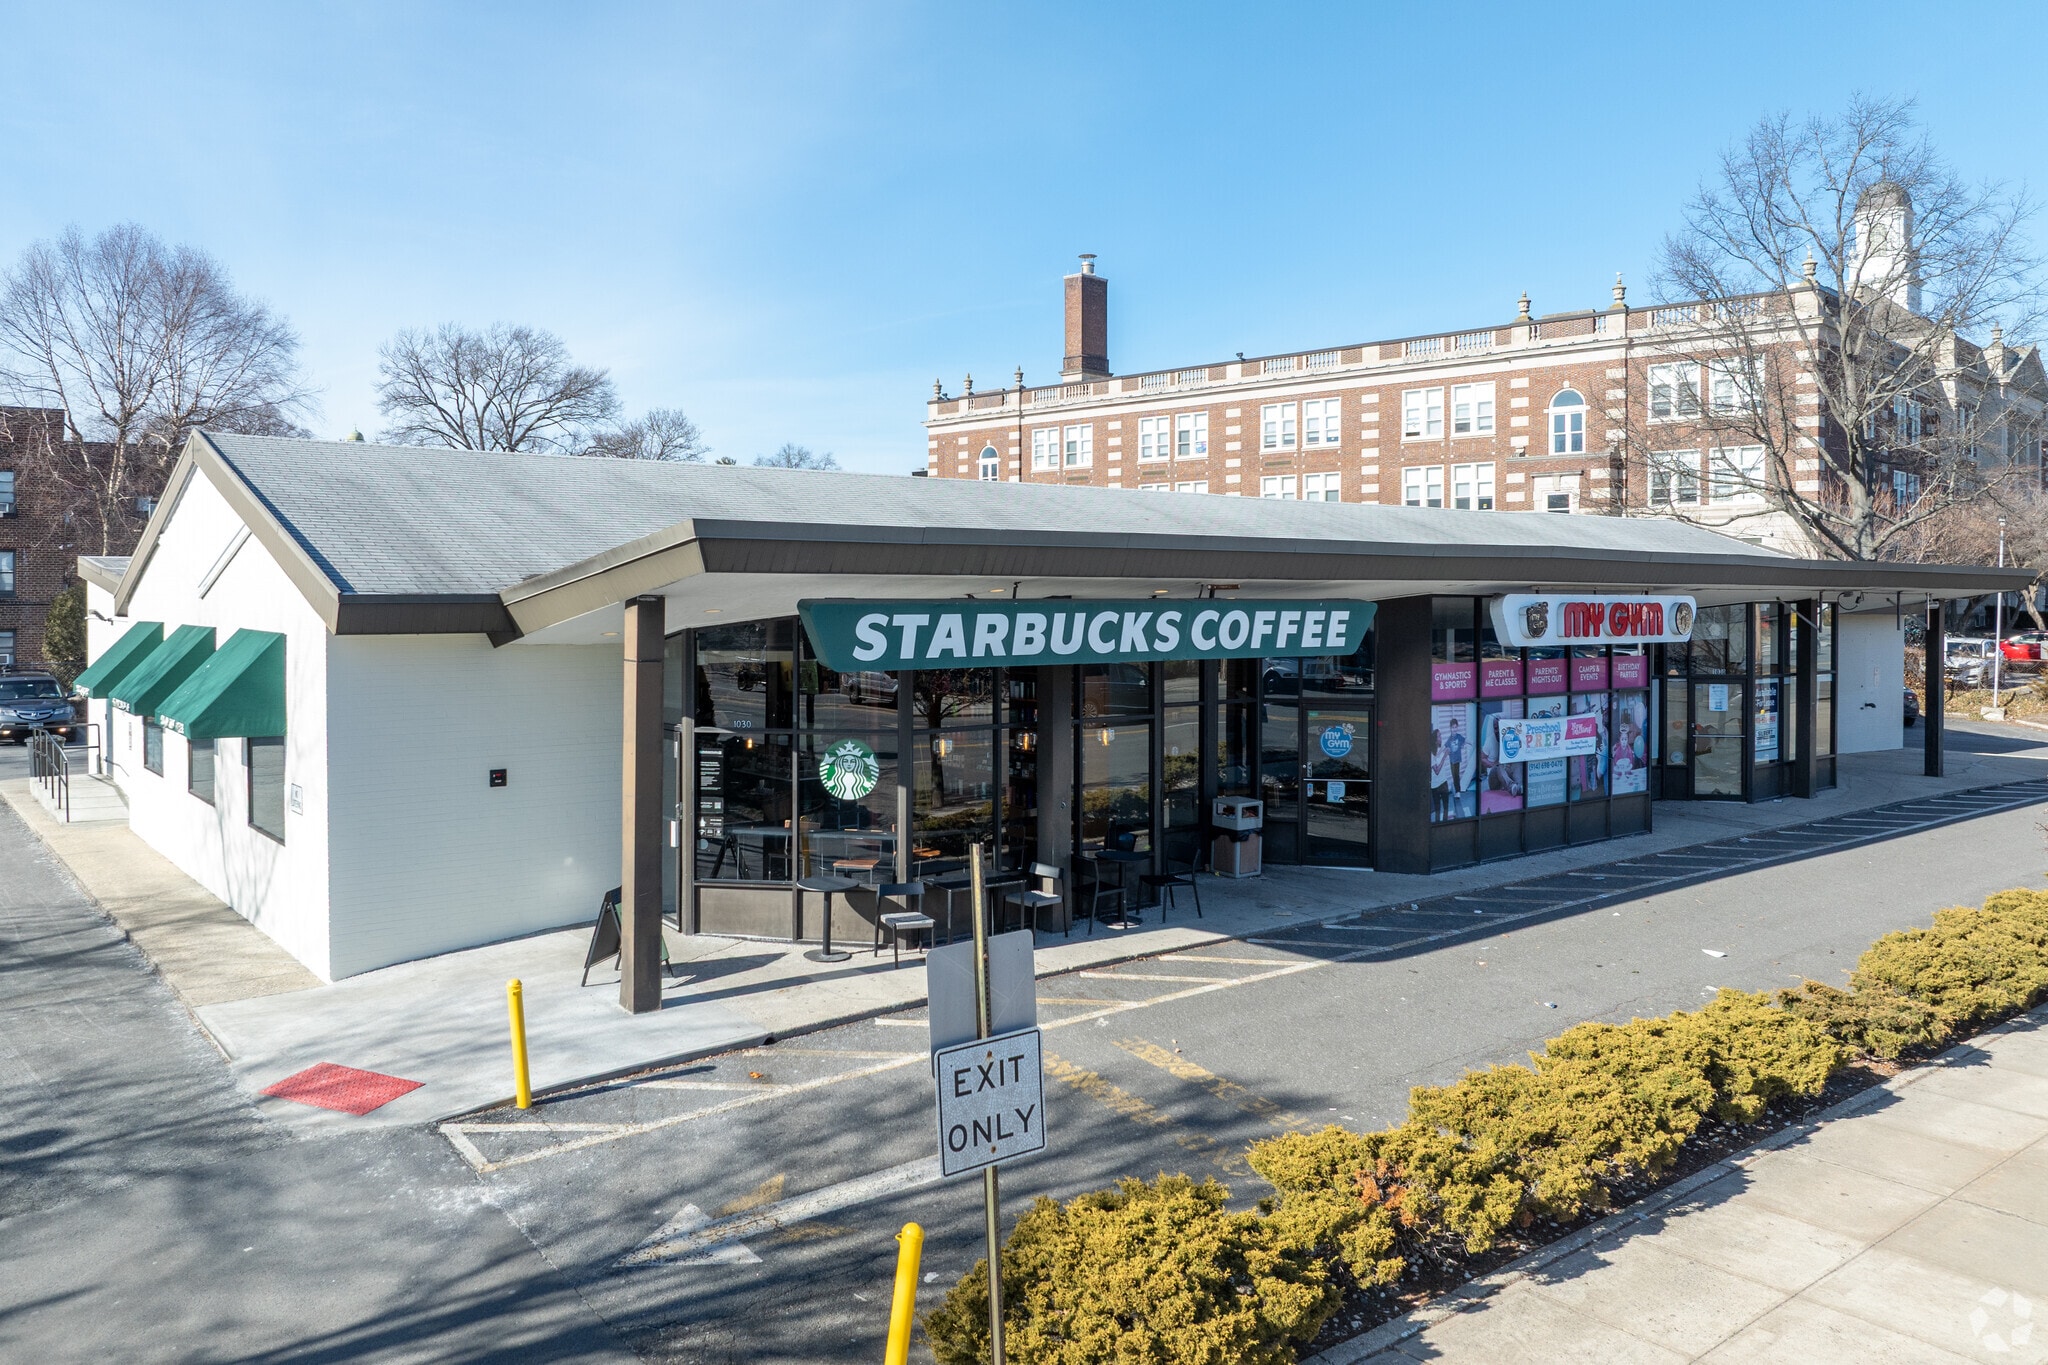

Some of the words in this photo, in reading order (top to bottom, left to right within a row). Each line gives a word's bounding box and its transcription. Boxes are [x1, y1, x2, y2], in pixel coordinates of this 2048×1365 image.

[1563, 602, 1605, 637] MY
[1608, 602, 1664, 637] GYM
[852, 610, 1181, 662] STARBUCKS
[1191, 609, 1350, 651] COFFEE
[1578, 665, 1596, 673] CAMPS
[1617, 663, 1640, 671] BIRTHDAY
[1434, 671, 1472, 681] GYMNASTICS
[1488, 669, 1510, 678] PARENT
[1510, 669, 1515, 677] &
[1580, 673, 1599, 681] EVENTS
[1619, 671, 1639, 679] PARTIES
[1485, 679, 1494, 687] ME
[1494, 677, 1518, 686] CLASSES
[1531, 675, 1551, 684] NIGHTS
[1551, 675, 1562, 683] OUT
[1439, 682, 1445, 690] &
[1445, 680, 1467, 689] SPORTS
[734, 720, 752, 728] 1030
[1525, 722, 1562, 735] Preschool
[1327, 740, 1350, 748] GYM
[1525, 733, 1561, 748] PREP
[954, 1054, 1024, 1098] EXIT
[948, 1103, 1036, 1152] ONLY
